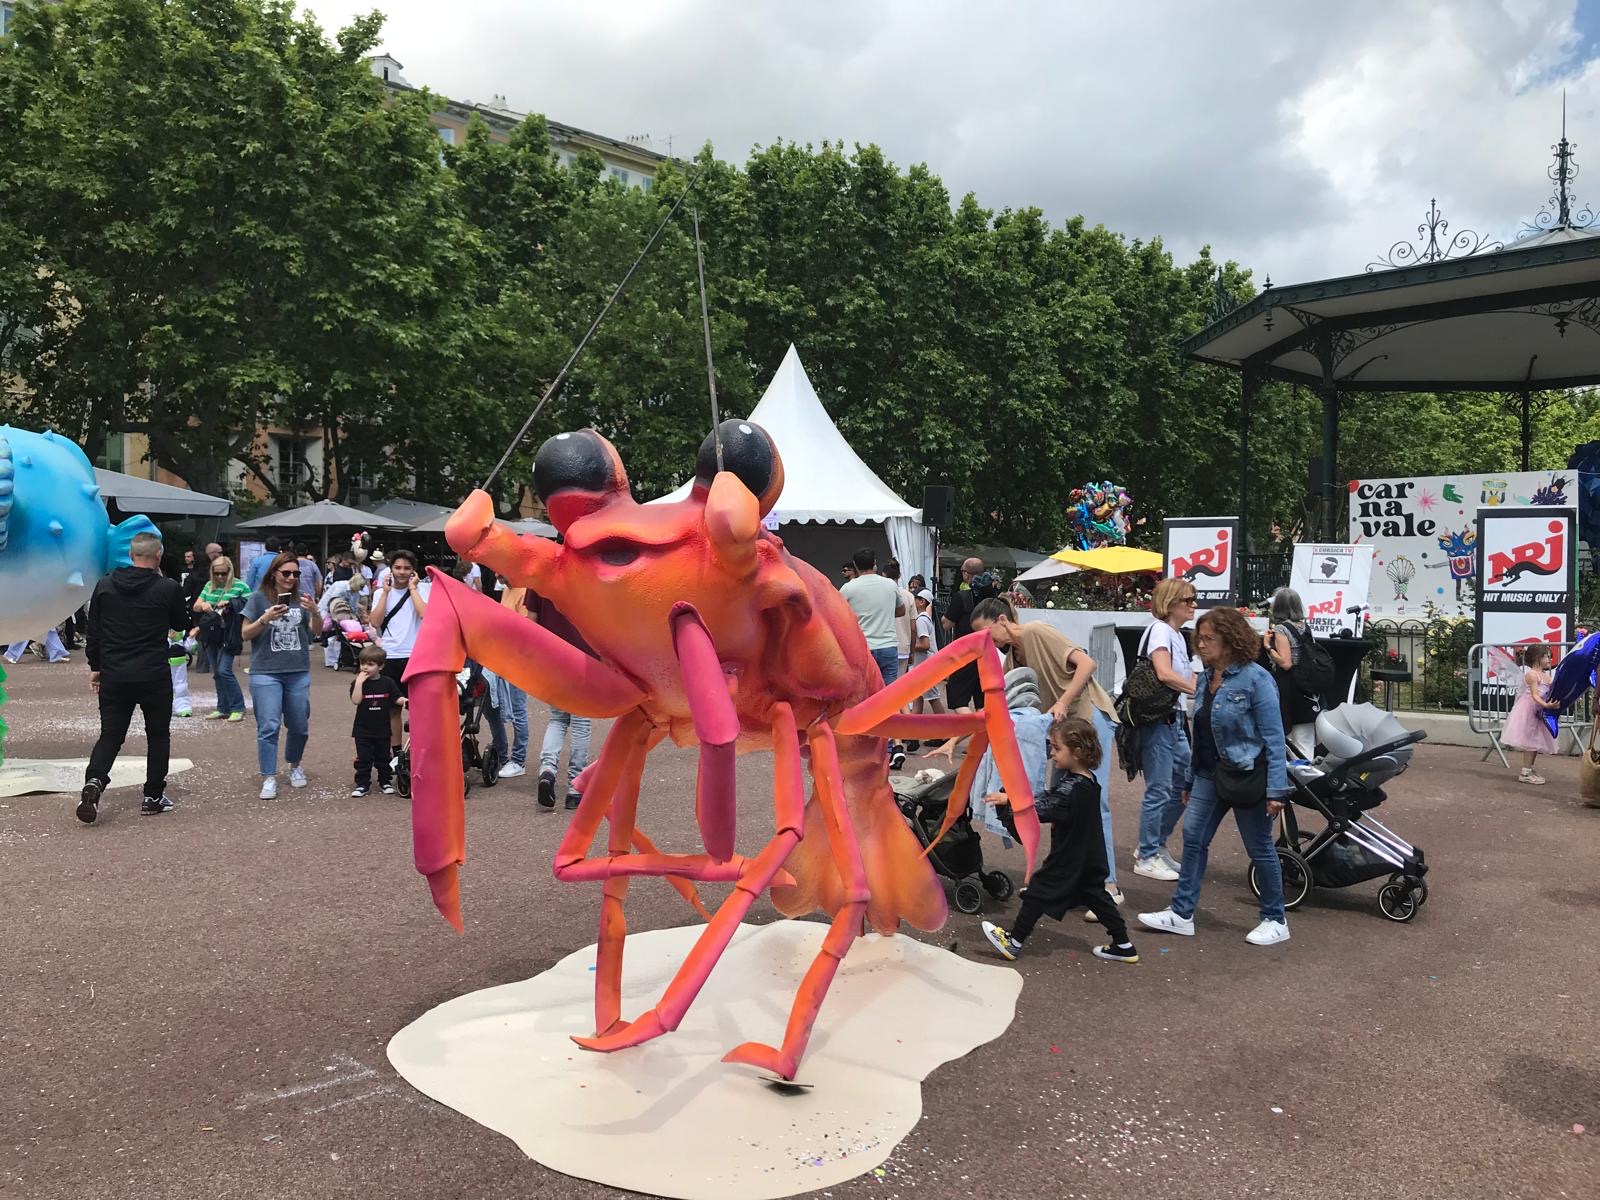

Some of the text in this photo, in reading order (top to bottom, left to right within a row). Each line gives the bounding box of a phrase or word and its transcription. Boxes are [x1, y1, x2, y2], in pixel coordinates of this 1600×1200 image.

[1358, 482, 1414, 499] car
[1359, 501, 1404, 517] na
[1360, 513, 1436, 537] vale
[1206, 592, 1225, 600] ONLY
[1483, 593, 1500, 601] HIT
[1501, 593, 1533, 602] MUSIC
[1534, 594, 1560, 603] ONLY
[1482, 686, 1497, 695] HIT
